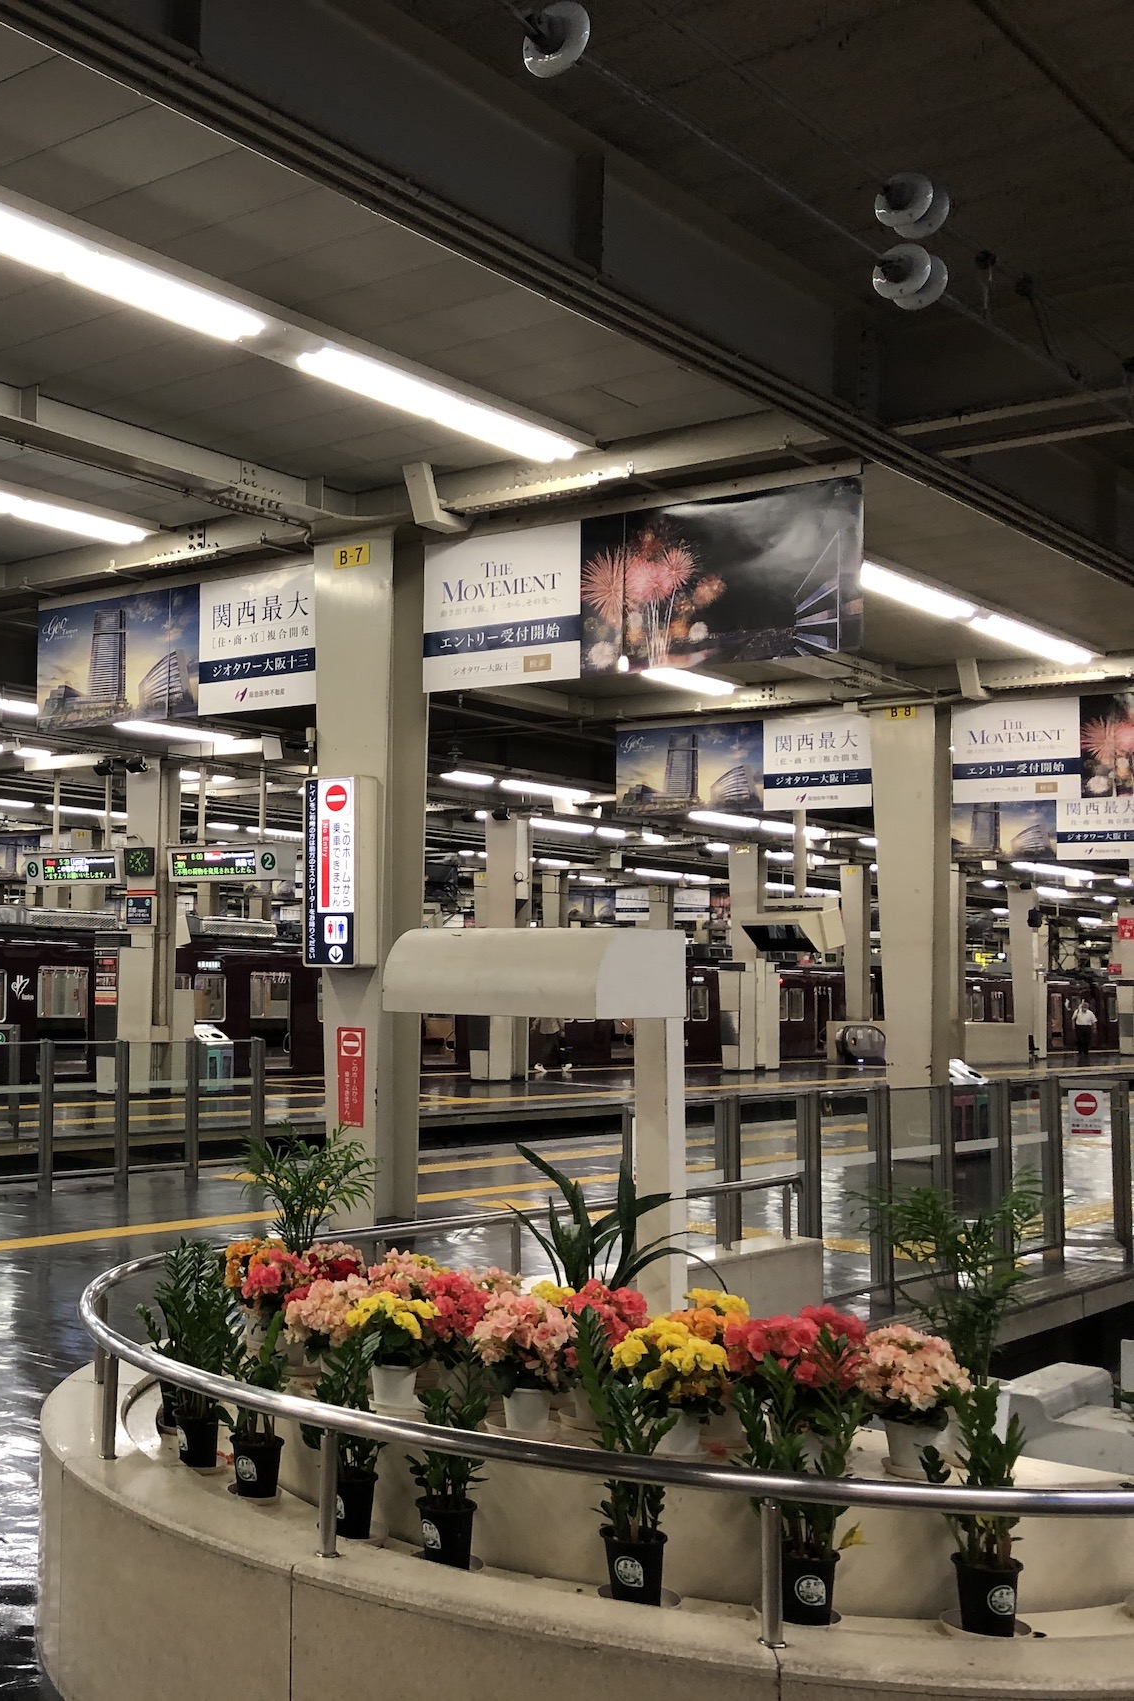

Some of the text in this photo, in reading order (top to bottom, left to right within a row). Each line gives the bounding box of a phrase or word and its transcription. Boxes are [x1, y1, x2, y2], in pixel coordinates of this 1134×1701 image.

[339, 547, 364, 566] B-7
[480, 561, 514, 579] THE
[441, 572, 562, 604] MOVEMENT
[212, 590, 309, 631] 関西最大
[440, 623, 562, 650] エントリー受付開始
[212, 653, 309, 679] ジオタワー大阪十三
[890, 706, 911, 717] B-8
[1000, 719, 1027, 730] THE
[775, 729, 858, 753] 関西最大
[967, 729, 1065, 745] MOVEMENT
[967, 761, 1065, 775] エントリー受付開始
[775, 772, 859, 787] ジオタワー大阪十三
[322, 823, 328, 834] No
[29, 863, 37, 877] 3
[264, 854, 273, 868] 2
[333, 823, 341, 907] 乗車できません
[342, 823, 351, 907] このホームから
